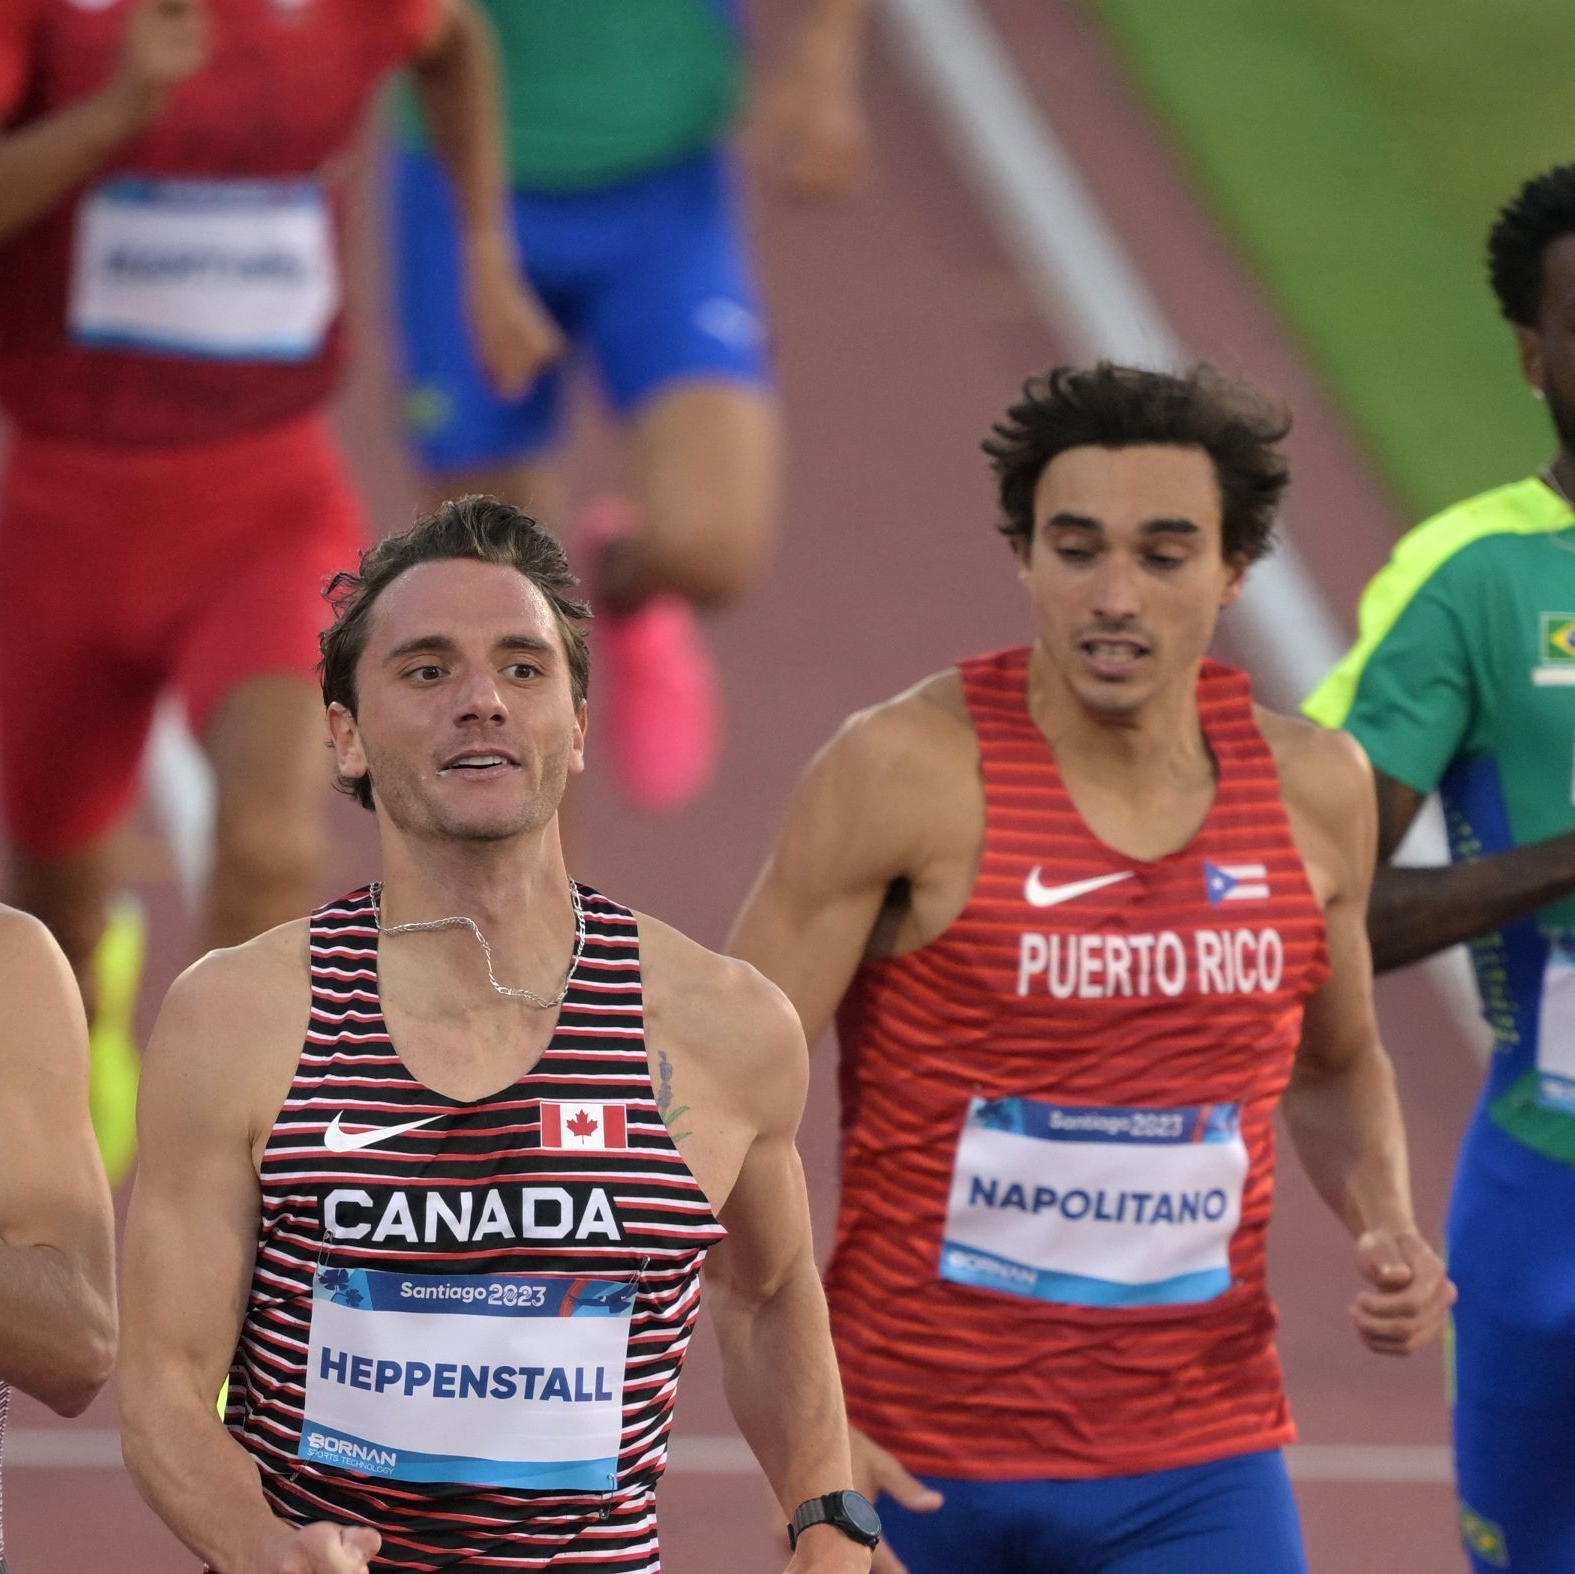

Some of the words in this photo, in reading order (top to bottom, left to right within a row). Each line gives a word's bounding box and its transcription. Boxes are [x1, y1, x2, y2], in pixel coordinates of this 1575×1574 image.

[1018, 931, 1186, 998] PUERTO
[1195, 928, 1283, 994] RICO
[324, 1187, 621, 1242] CANADA
[967, 1176, 1228, 1226] NAPOLITANO
[319, 1346, 613, 1403] HEPPENSTALL
[307, 1432, 396, 1467] BORNAN
[341, 1456, 394, 1475] TECHNOLOGY
